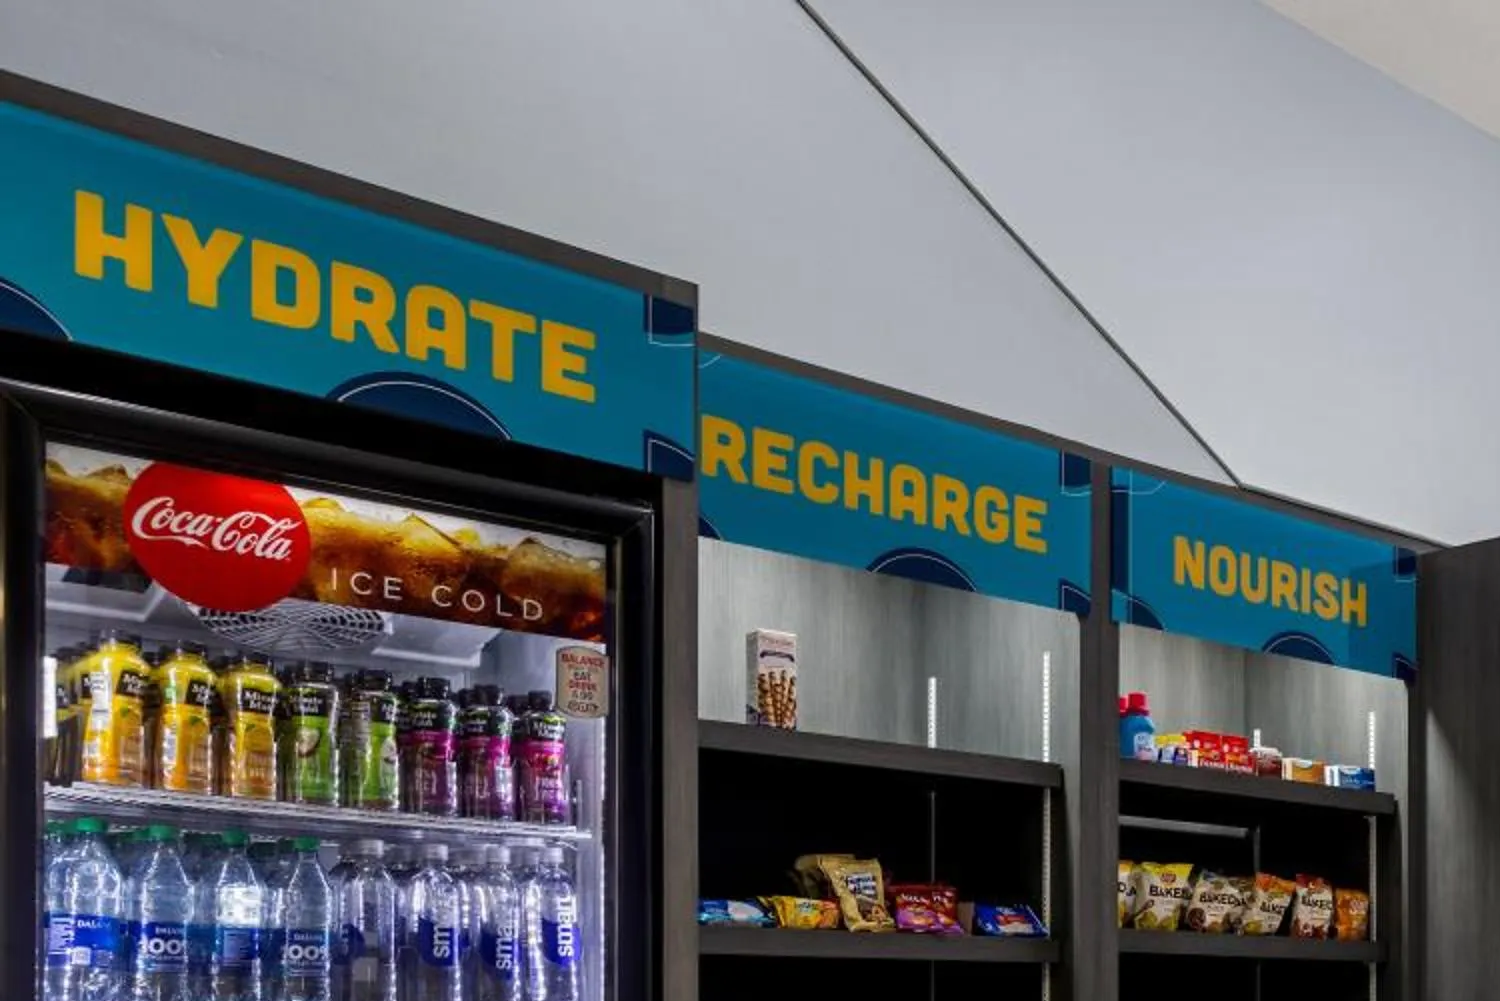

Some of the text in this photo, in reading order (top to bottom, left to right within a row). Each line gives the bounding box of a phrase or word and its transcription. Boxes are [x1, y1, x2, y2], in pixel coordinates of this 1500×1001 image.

[75, 189, 597, 404] HYDRATE
[131, 494, 294, 564] Coca-Cola
[700, 414, 1048, 553] RECHARGE
[330, 566, 545, 622] ICE COLD
[1172, 535, 1367, 627] NOURISH
